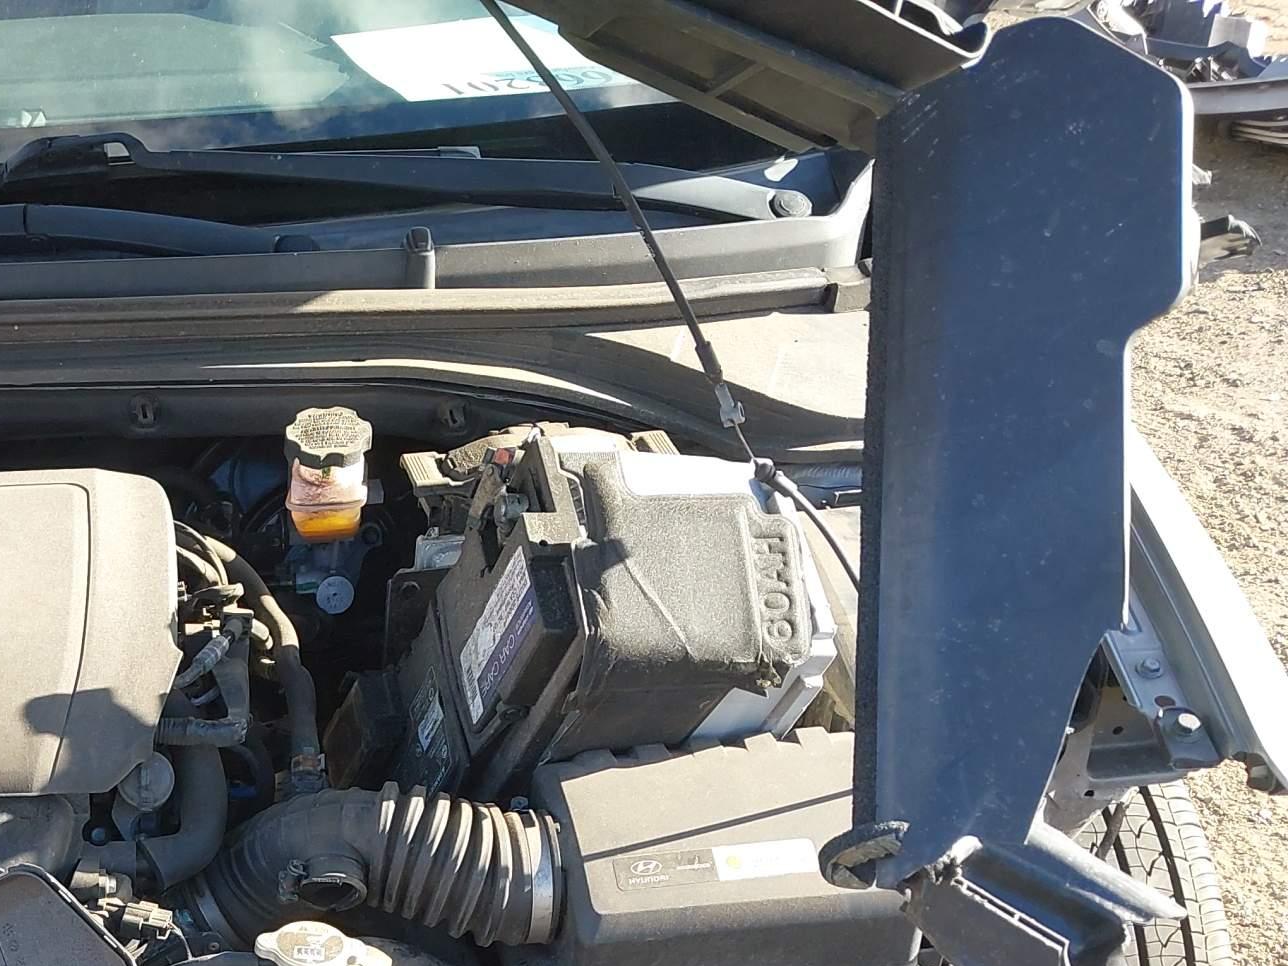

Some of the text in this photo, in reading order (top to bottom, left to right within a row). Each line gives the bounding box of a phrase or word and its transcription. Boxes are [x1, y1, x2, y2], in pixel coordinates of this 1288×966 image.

[752, 537, 793, 642] 60AH
[499, 634, 515, 664] CAR
[628, 874, 670, 885] HYUNDAI
